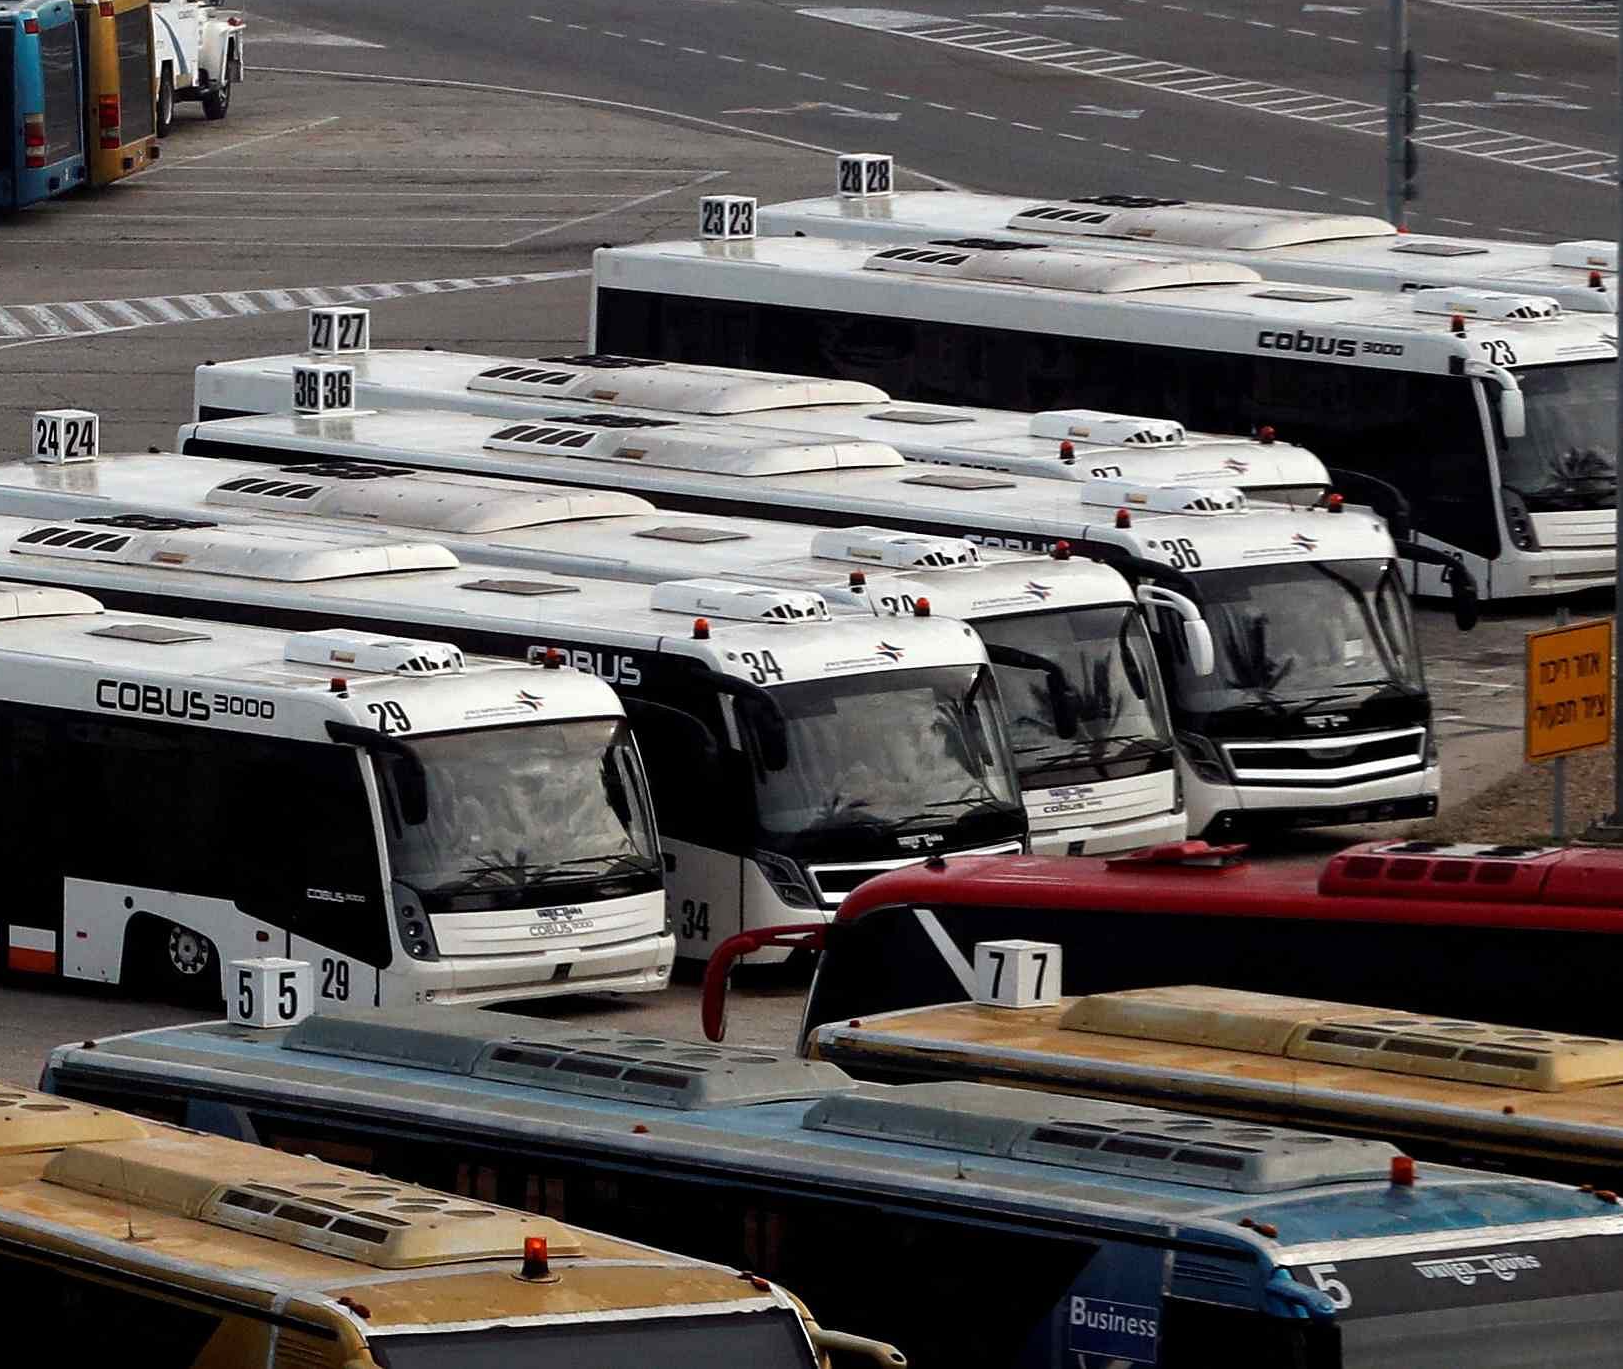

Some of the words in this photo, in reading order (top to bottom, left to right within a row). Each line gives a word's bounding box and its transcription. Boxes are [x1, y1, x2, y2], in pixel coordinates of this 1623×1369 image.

[840, 159, 862, 193] 28
[867, 159, 891, 193] 28
[702, 201, 725, 235] 23
[729, 202, 753, 236] 23
[312, 313, 332, 349] 27
[337, 314, 364, 349] 27
[1258, 329, 1358, 357] cobus
[1362, 341, 1404, 357] 3000
[1480, 340, 1517, 367] 23
[296, 370, 318, 408] 36
[323, 371, 352, 409] 36
[37, 418, 59, 457] 24
[66, 419, 95, 458] 24
[1160, 538, 1202, 569] 36
[741, 650, 784, 685] 34
[96, 679, 211, 722] COBUS
[213, 694, 276, 720] 3000
[367, 700, 412, 733] 29
[529, 925, 573, 937] COBUS
[682, 899, 711, 941] 34
[321, 957, 350, 1001] 29
[989, 951, 1005, 999] 7
[1032, 952, 1048, 1000] 7
[238, 970, 254, 1020] 5
[278, 971, 298, 1020] 5
[1306, 1263, 1353, 1309] 5
[1069, 1294, 1157, 1339] Business
